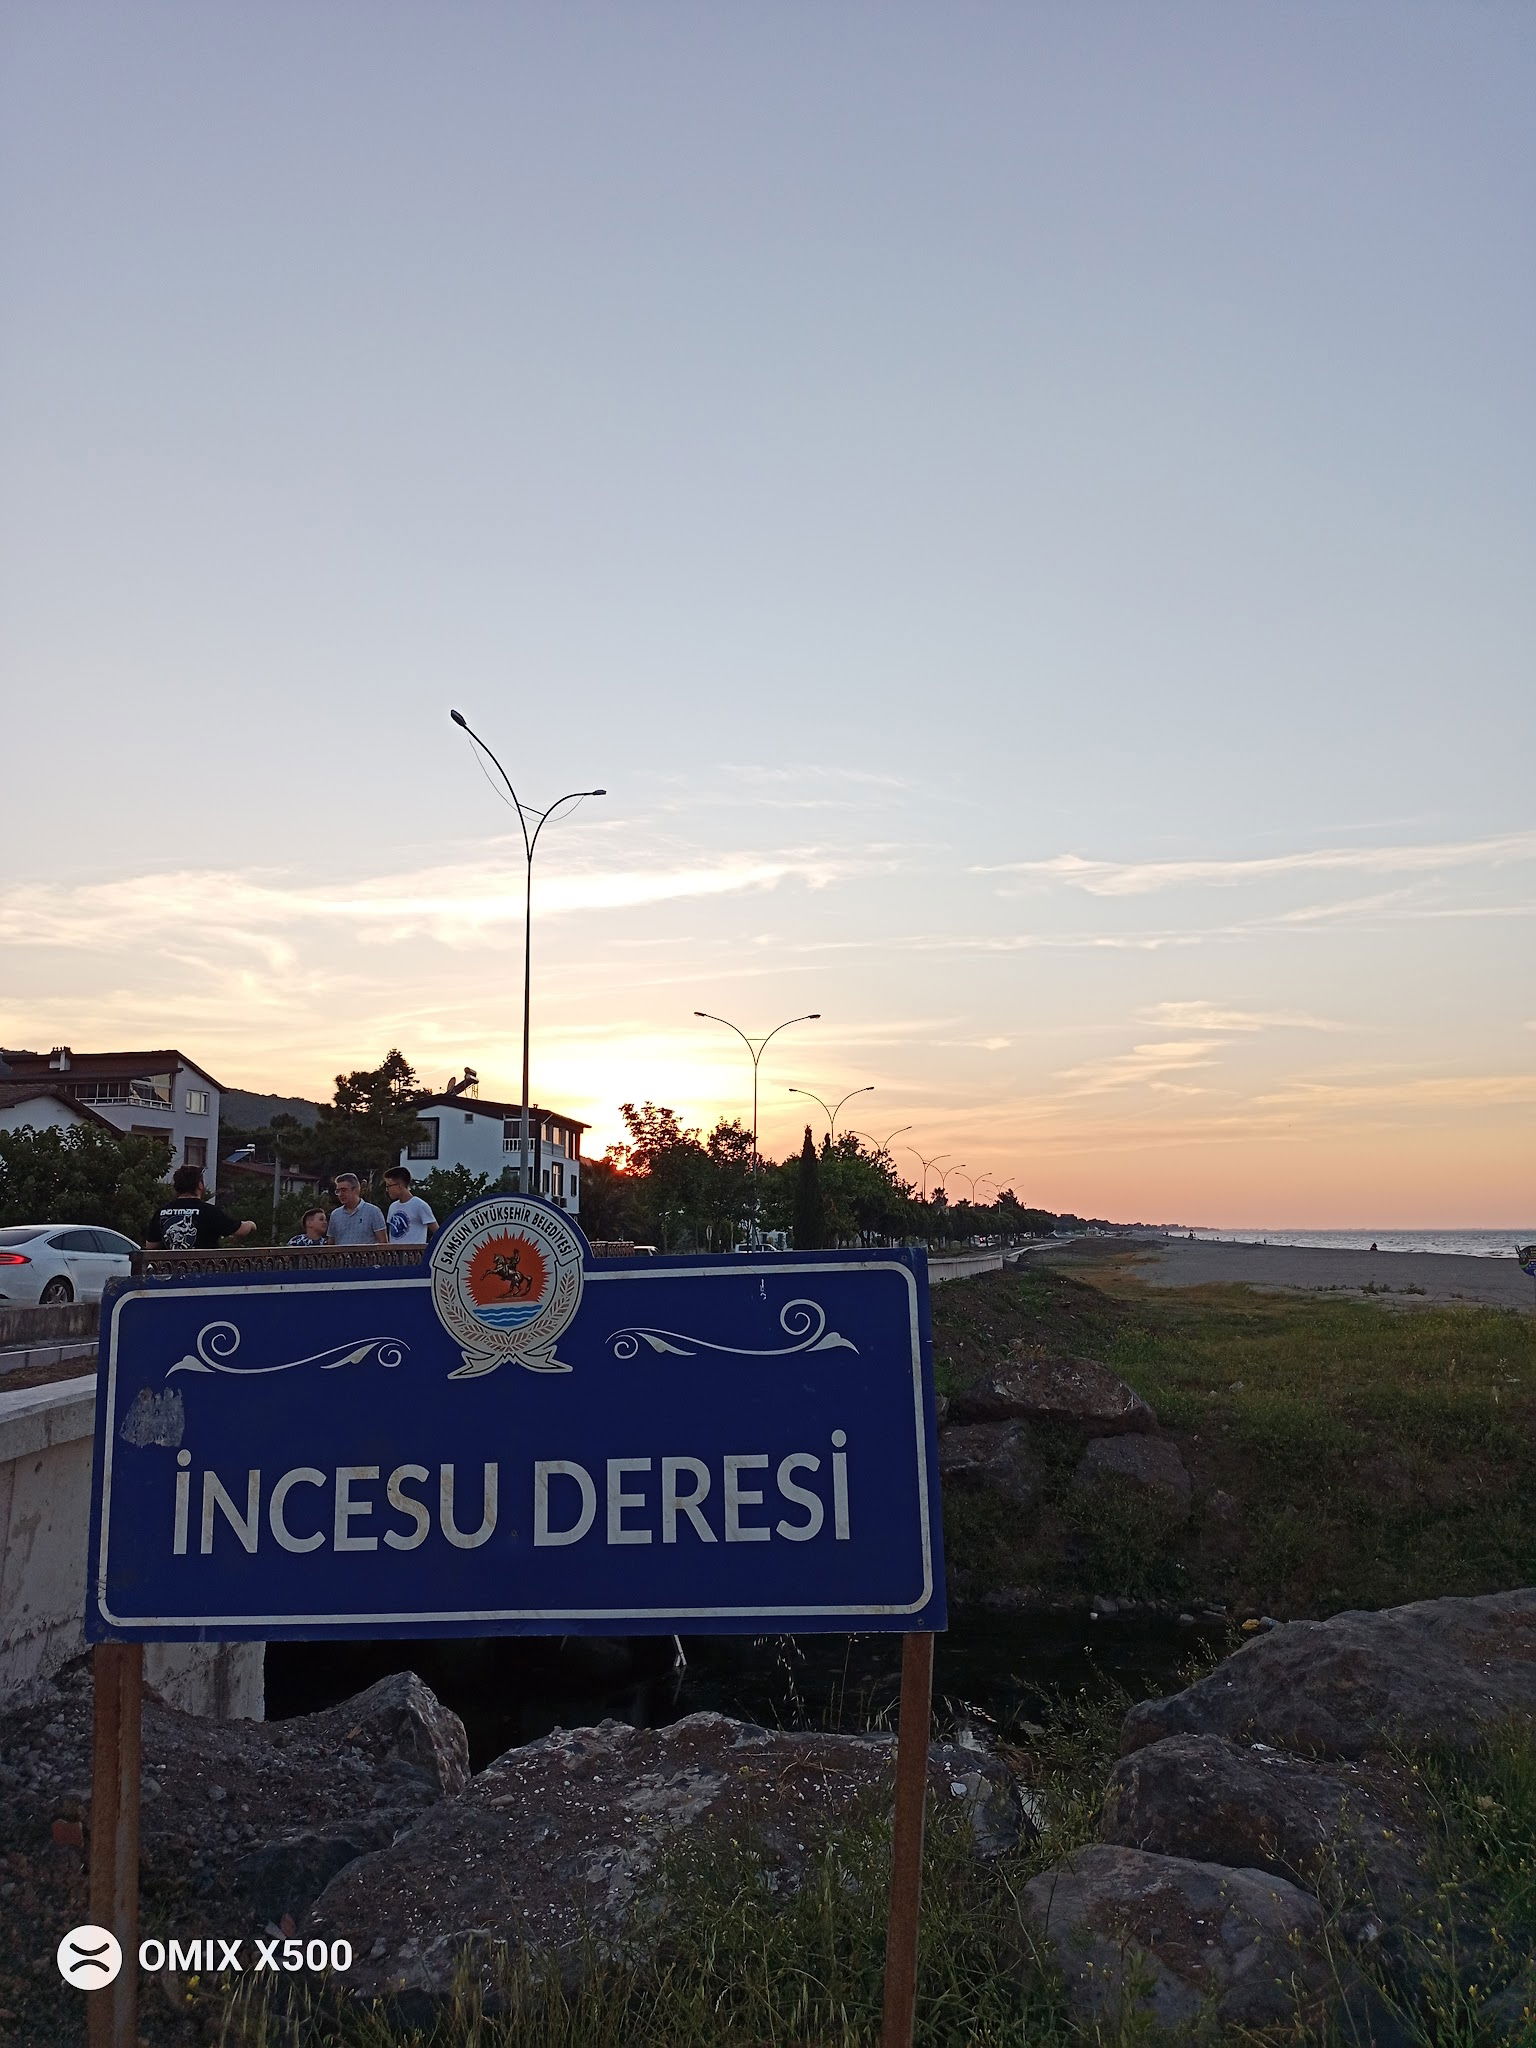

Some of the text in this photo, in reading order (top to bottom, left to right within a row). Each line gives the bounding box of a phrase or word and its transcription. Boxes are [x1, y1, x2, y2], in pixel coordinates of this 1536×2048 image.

[440, 1204, 576, 1265] SAMSUN BÜYÜKŞEHİR BELEDİYESİ
[173, 1429, 852, 1555] İNCESU DERESİ
